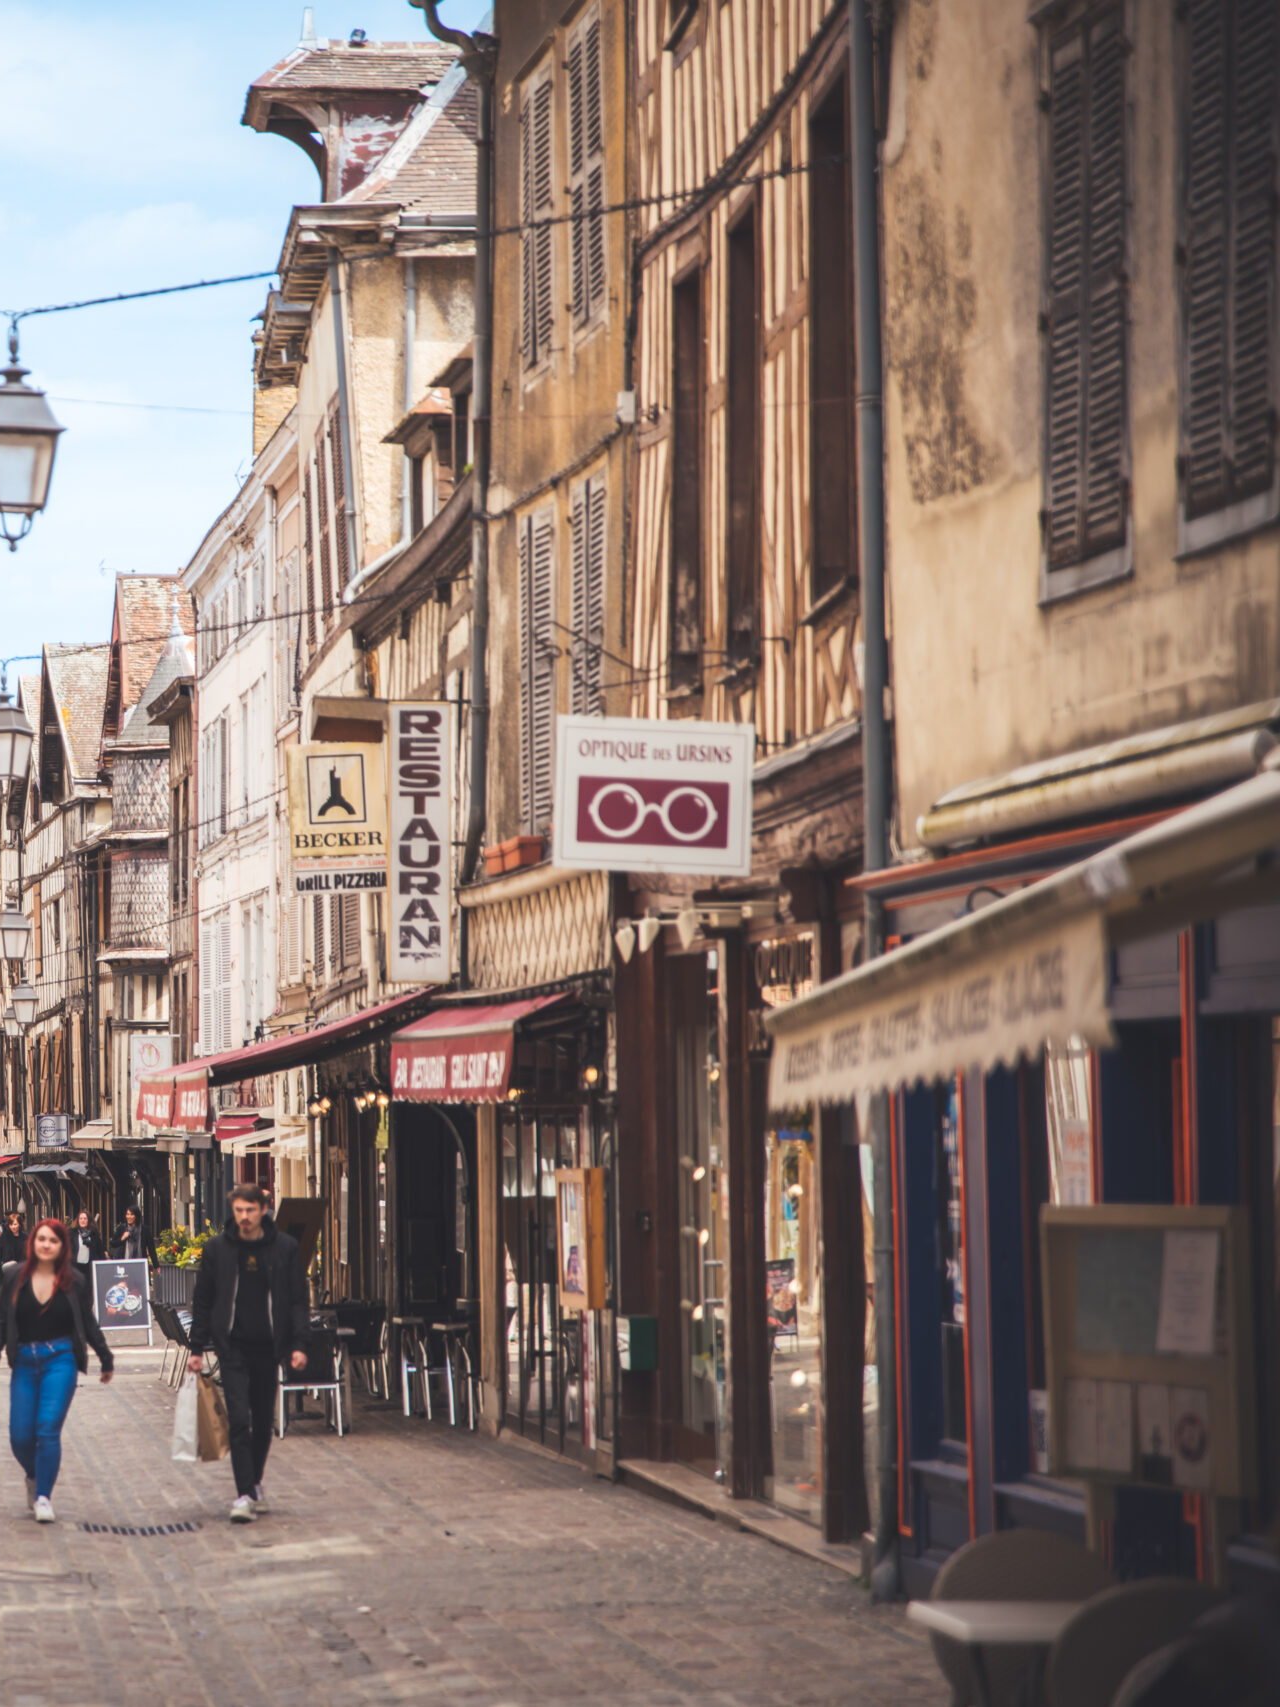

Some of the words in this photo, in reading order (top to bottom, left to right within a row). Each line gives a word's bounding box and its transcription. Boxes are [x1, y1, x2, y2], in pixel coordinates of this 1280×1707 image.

[578, 739, 647, 762] OPTIQUE
[652, 748, 672, 761] DES
[676, 744, 733, 764] URSINS
[295, 831, 384, 849] BECKER
[399, 710, 442, 963] RESTAURAN
